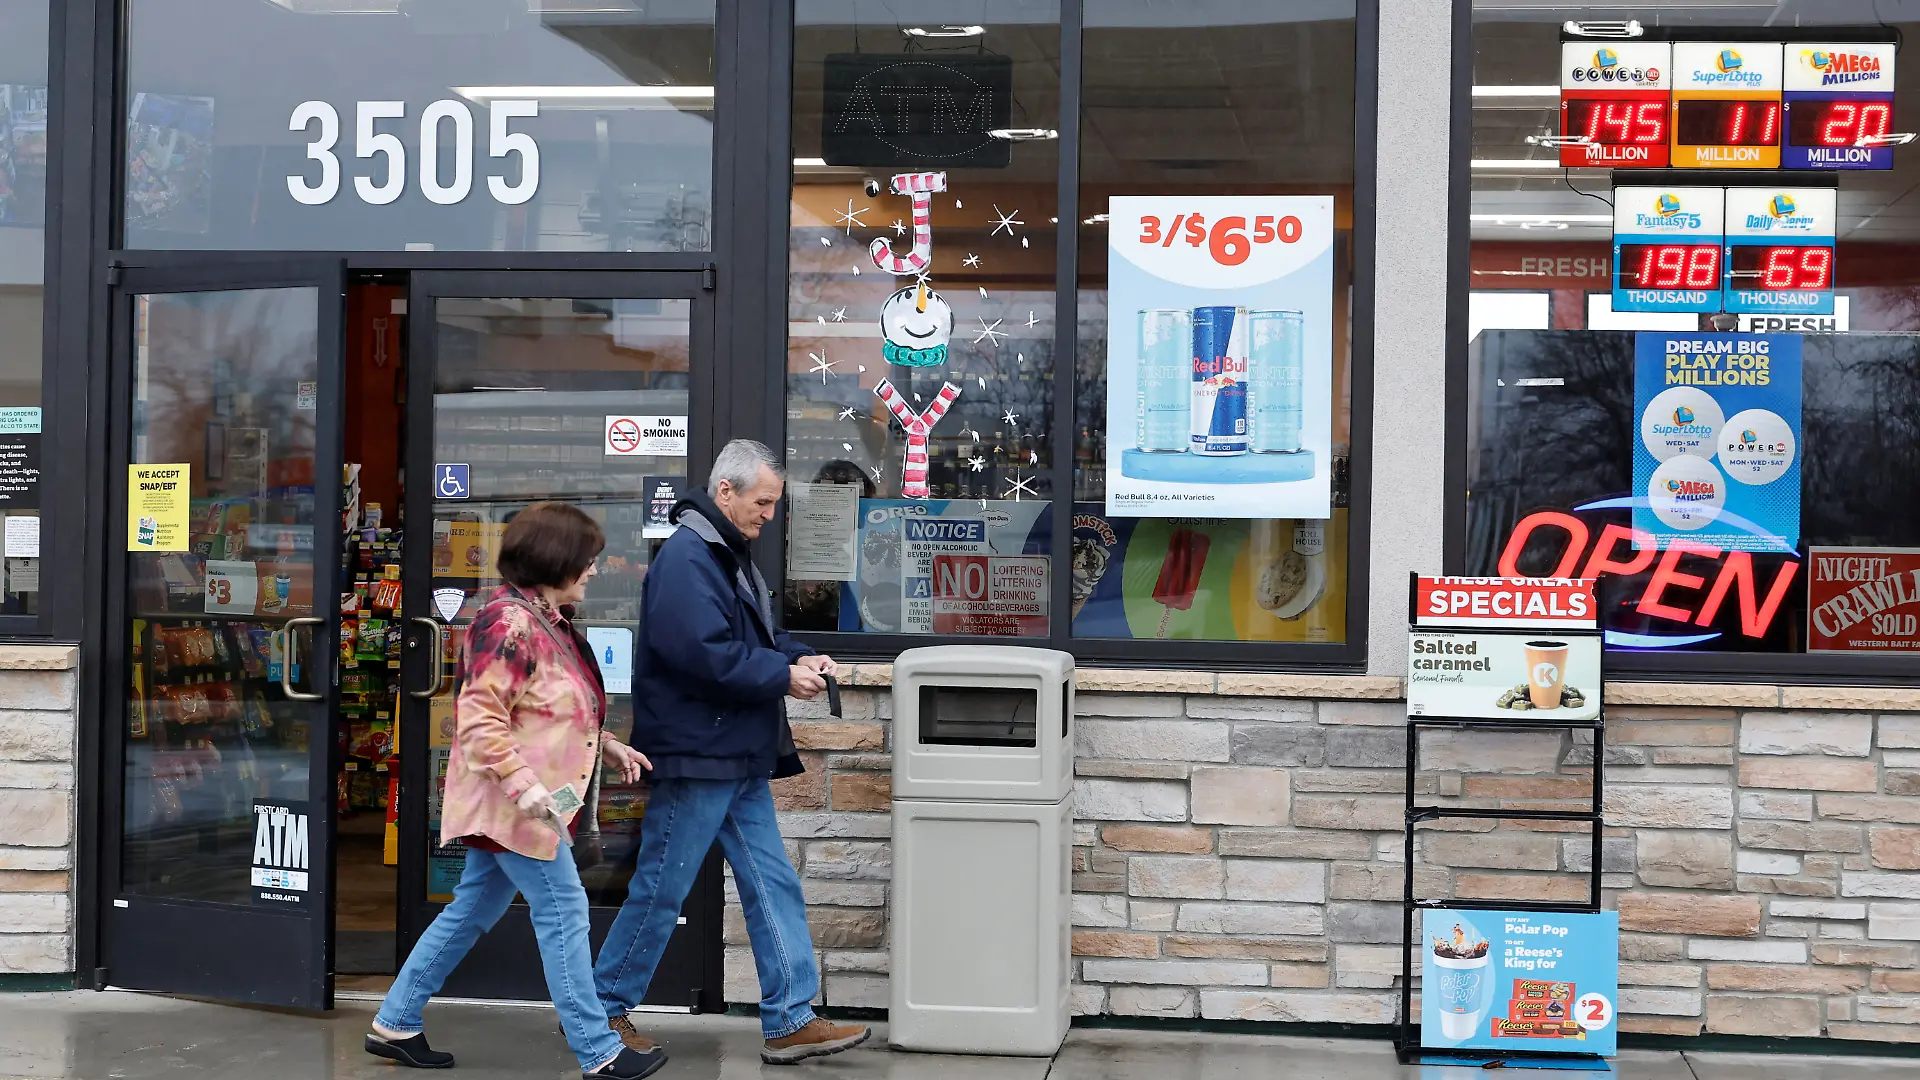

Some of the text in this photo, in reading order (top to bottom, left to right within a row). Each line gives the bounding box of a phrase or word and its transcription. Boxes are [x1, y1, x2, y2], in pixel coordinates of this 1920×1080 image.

[1824, 52, 1881, 74] MEGA
[1692, 70, 1763, 85] SuperLotto
[1822, 71, 1880, 86] MILLIONS
[834, 85, 993, 134] ATM
[1587, 104, 1663, 141] 145
[1731, 106, 1776, 141] 11
[1824, 105, 1889, 143] 20
[286, 99, 540, 205] 3505
[1585, 146, 1648, 160] MILLION
[1696, 147, 1760, 161] MILLION
[1807, 148, 1872, 162] MILLION
[1636, 213, 1701, 230] Fantasy 5
[1746, 214, 1773, 231] Daily
[1521, 257, 1607, 277] FRESH
[1641, 248, 1718, 286] 198
[1766, 249, 1830, 287] 69
[1627, 290, 1707, 304] THOUSAND
[1739, 292, 1819, 305] THOUSAND
[1750, 317, 1836, 331] FRESH
[1665, 340, 1769, 354] DREAM BIG
[1194, 357, 1248, 373] Red Bull
[1665, 354, 1770, 370] PLAY FOR
[1665, 370, 1771, 386] MILLIONS
[658, 418, 672, 427] NO
[643, 429, 686, 438] SMOKING
[1652, 424, 1712, 436] SuperLotto
[137, 470, 180, 479] WE ACCEPT
[140, 482, 177, 491] SNAP/EBT
[1677, 481, 1715, 495] MEGA
[867, 505, 928, 524] OREO
[911, 522, 979, 539] NOTICE
[1299, 530, 1319, 538] TOLL
[911, 543, 978, 552] NO OPEN ALCOHOLIC
[1295, 538, 1322, 546] HOUSE
[993, 565, 1044, 575] LOITERING
[1497, 511, 1799, 638] OPEN
[1816, 557, 1891, 582] NIGHT
[941, 562, 985, 599] NO
[993, 577, 1042, 588] LITTERING
[208, 578, 232, 605] $3
[993, 590, 1036, 601] DRINKING
[942, 602, 1040, 612] OF ALCOHOLIC BEVERAGES
[1429, 589, 1588, 617] SPECIALS
[962, 616, 1003, 624] VIOLATORS
[1871, 613, 1917, 636] SOLD
[955, 625, 986, 633] SUBJECT
[1413, 639, 1477, 655] Salted
[1849, 640, 1888, 648] WESTERN
[1891, 640, 1909, 648] BAIT
[1413, 657, 1491, 671] caramel
[270, 666, 296, 678] PUL
[254, 805, 289, 815] FIRSTCARD
[253, 813, 309, 869] ATM
[1505, 924, 1568, 937] Polar Pop
[1504, 948, 1512, 956] a
[1504, 957, 1556, 970] King for
[1441, 972, 1471, 990] Polar
[1452, 986, 1475, 1004] Pop
[1581, 999, 1604, 1021] $2
